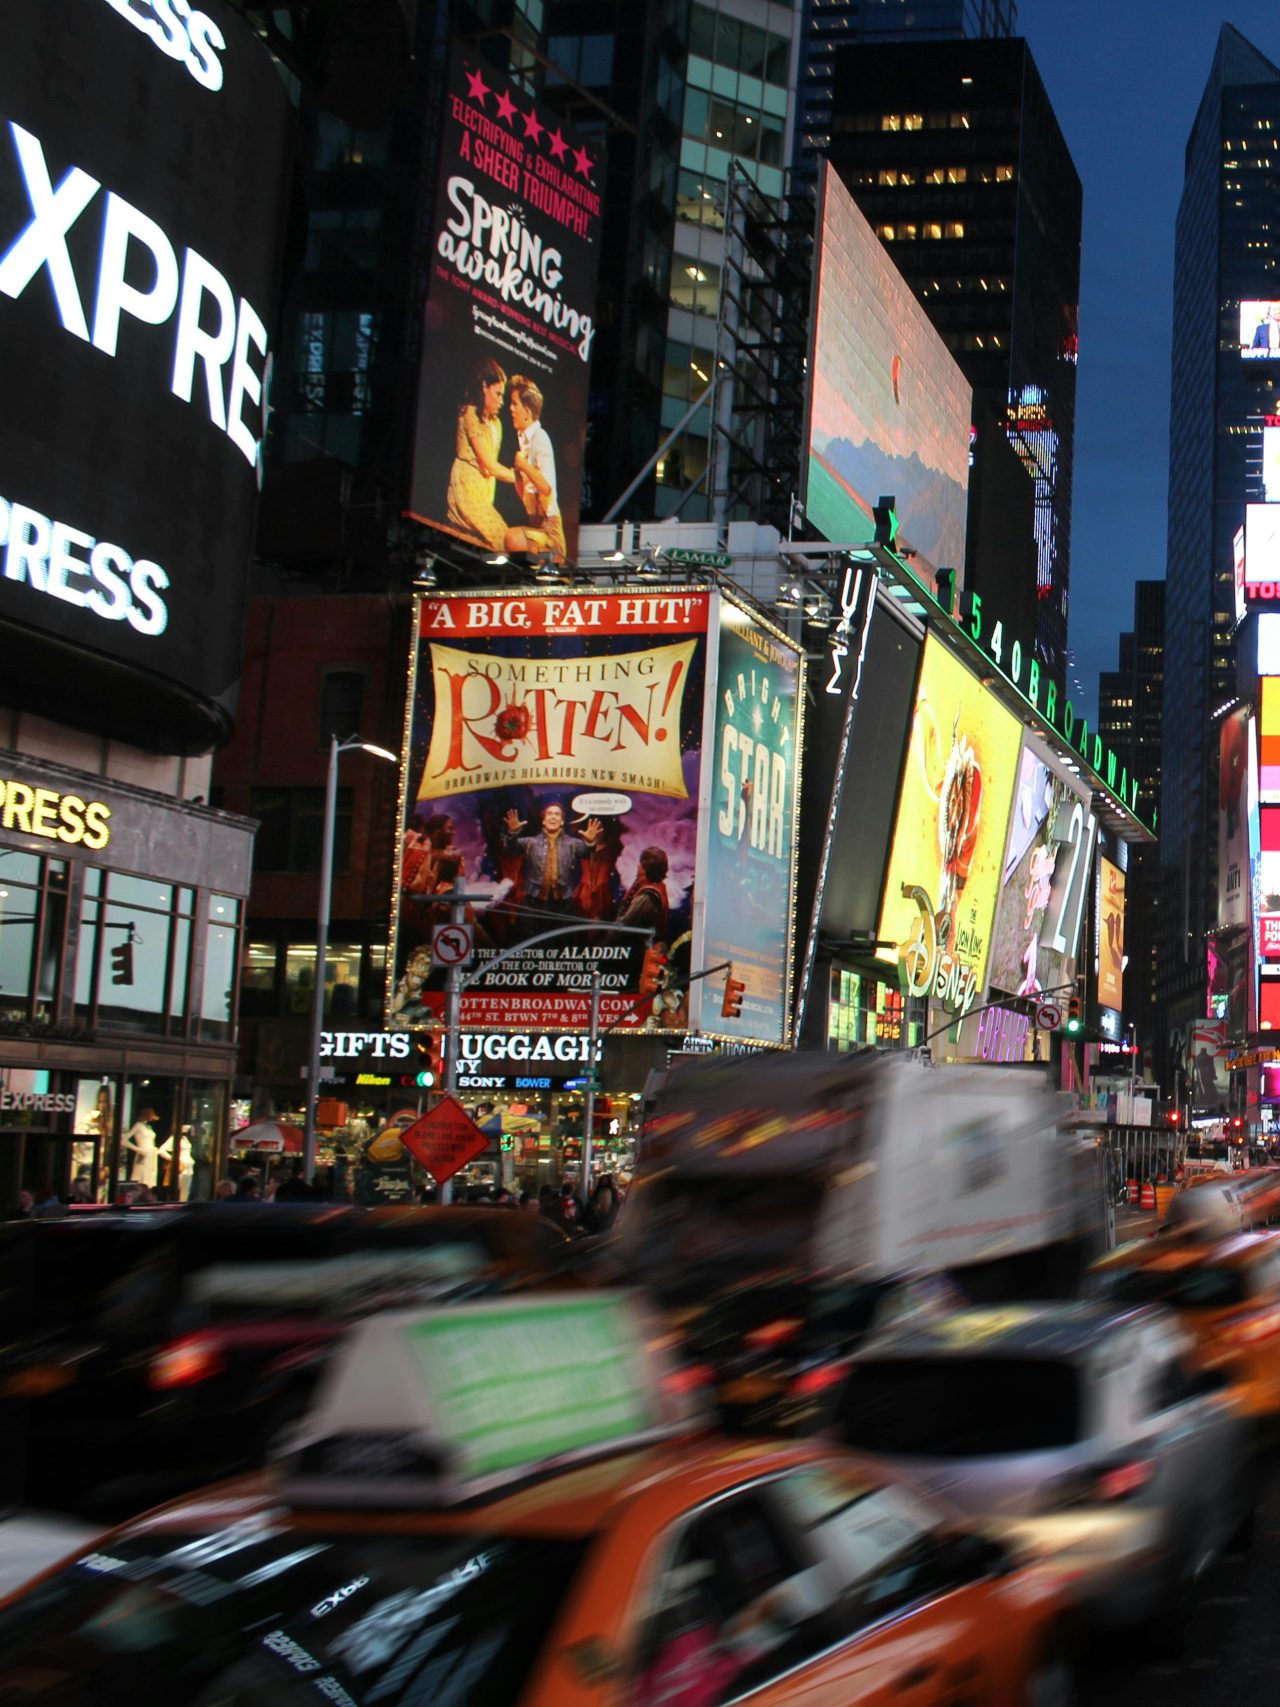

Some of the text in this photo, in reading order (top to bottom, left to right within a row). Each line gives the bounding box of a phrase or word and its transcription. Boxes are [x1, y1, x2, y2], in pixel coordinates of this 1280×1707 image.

[460, 130, 471, 162] A
[473, 137, 520, 193] SHEER
[525, 152, 533, 170] &
[446, 176, 563, 289] SPRING
[437, 230, 596, 362] awakening
[671, 549, 729, 566] LAMAR
[542, 600, 607, 626] FAT
[467, 656, 656, 684] SOMETHING
[724, 669, 788, 747] BRIGHT
[1028, 658, 1139, 812] BROADWAY
[521, 766, 587, 780] HILARIOUS
[591, 768, 616, 782] NEW
[621, 772, 666, 788] SMASH!
[718, 723, 786, 859] STAR
[0, 779, 111, 849] RESS
[1053, 802, 1096, 959] 21
[1226, 869, 1241, 893] ANTI
[478, 949, 496, 959] THE
[546, 949, 558, 959] OF
[559, 946, 631, 960] ALADDIN
[479, 961, 599, 971] AD THE CO-DIRECTOR OF
[485, 973, 530, 986] BOOK
[532, 973, 552, 986] OF
[485, 1012, 500, 1022] ST.
[504, 1012, 538, 1022] BTWN
[541, 1012, 558, 1022] 7TH
[560, 1013, 569, 1023] &
[571, 1012, 588, 1022] 8TH
[597, 1013, 620, 1023] VES
[319, 1032, 411, 1058] GIFTS
[440, 1034, 603, 1062] UGGAGE
[356, 1073, 392, 1086] Nikon
[459, 1077, 506, 1088] SONY
[515, 1077, 552, 1088] BOWER
[0, 1091, 76, 1113] EXPRESS
